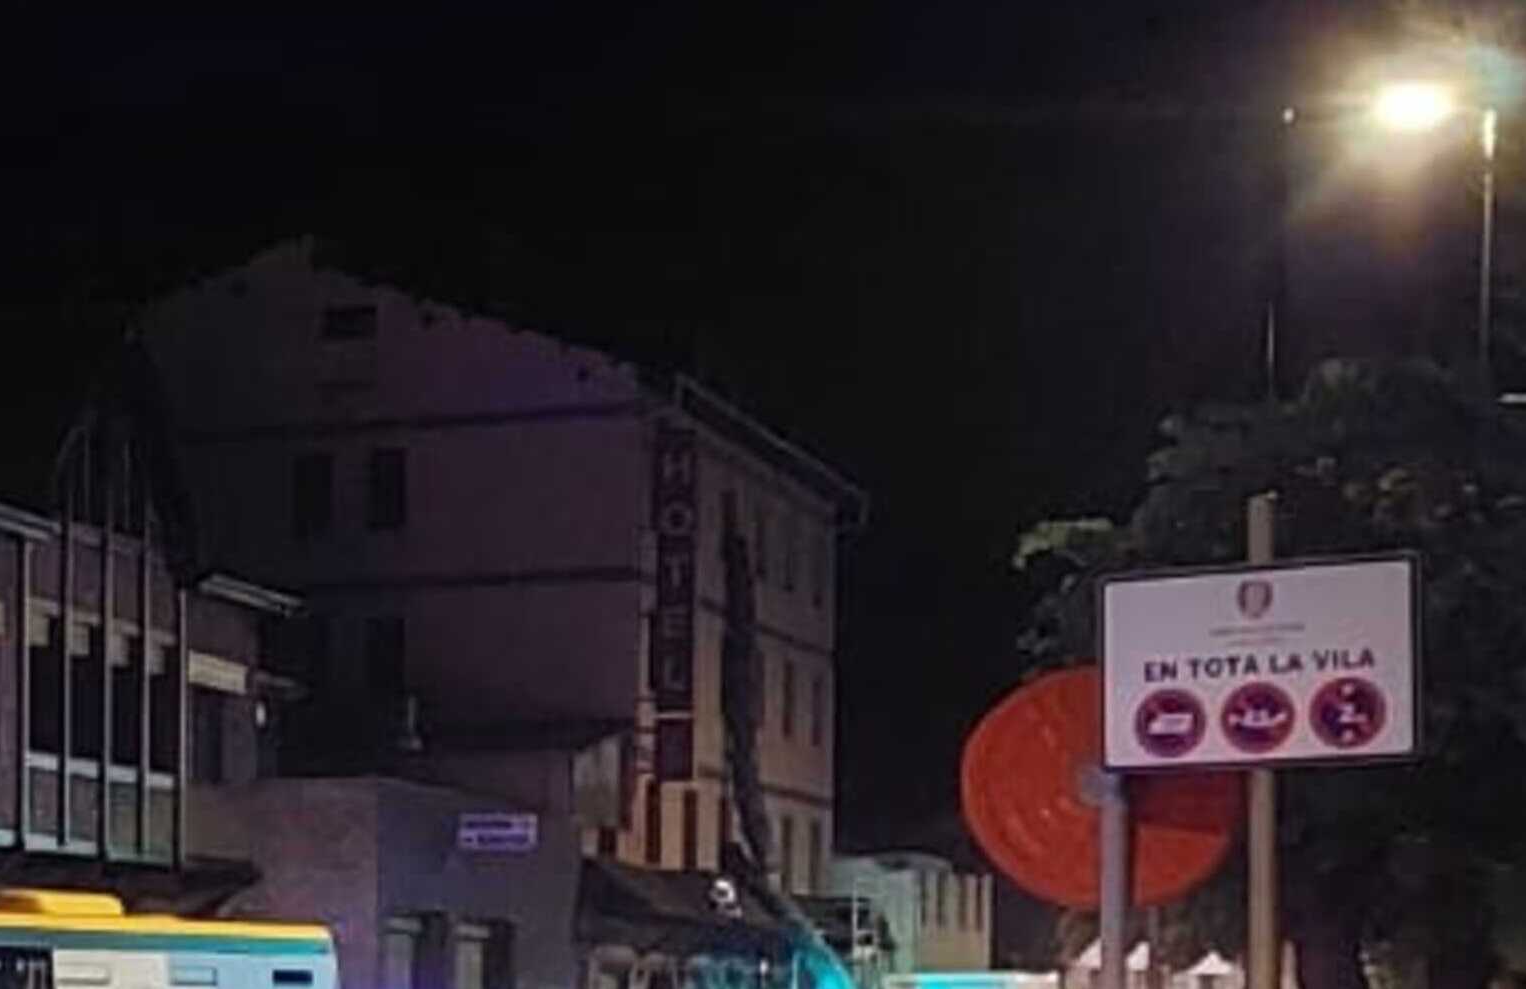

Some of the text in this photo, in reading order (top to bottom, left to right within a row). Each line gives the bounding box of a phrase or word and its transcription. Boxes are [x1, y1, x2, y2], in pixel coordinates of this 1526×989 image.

[661, 452, 693, 690] HOTEL
[1144, 647, 1374, 682] EN TOTA LA VILA
